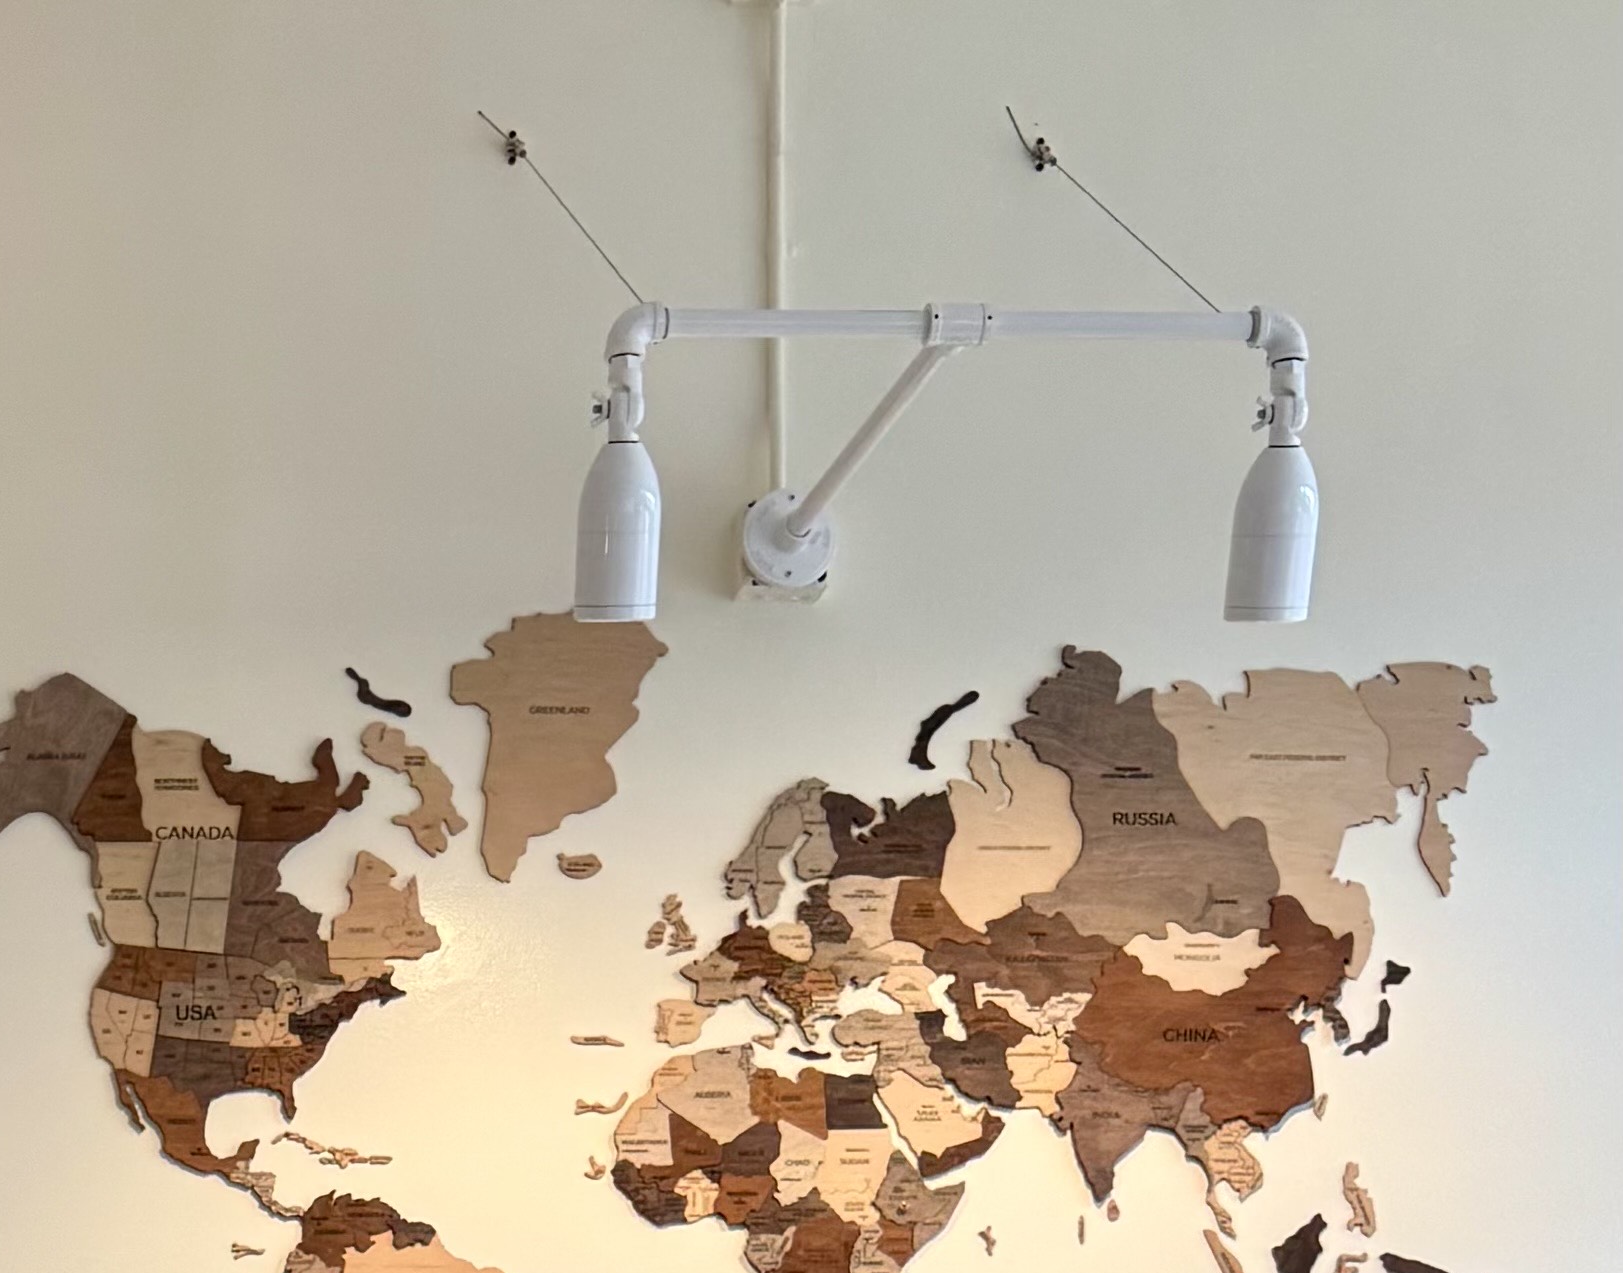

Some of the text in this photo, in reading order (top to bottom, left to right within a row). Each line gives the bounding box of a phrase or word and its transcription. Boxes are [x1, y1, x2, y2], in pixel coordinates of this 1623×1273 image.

[1112, 812, 1177, 826] RUSSIA
[155, 826, 234, 841] CANADA
[176, 1004, 217, 1021] USA
[1162, 1028, 1222, 1043] CHINA
